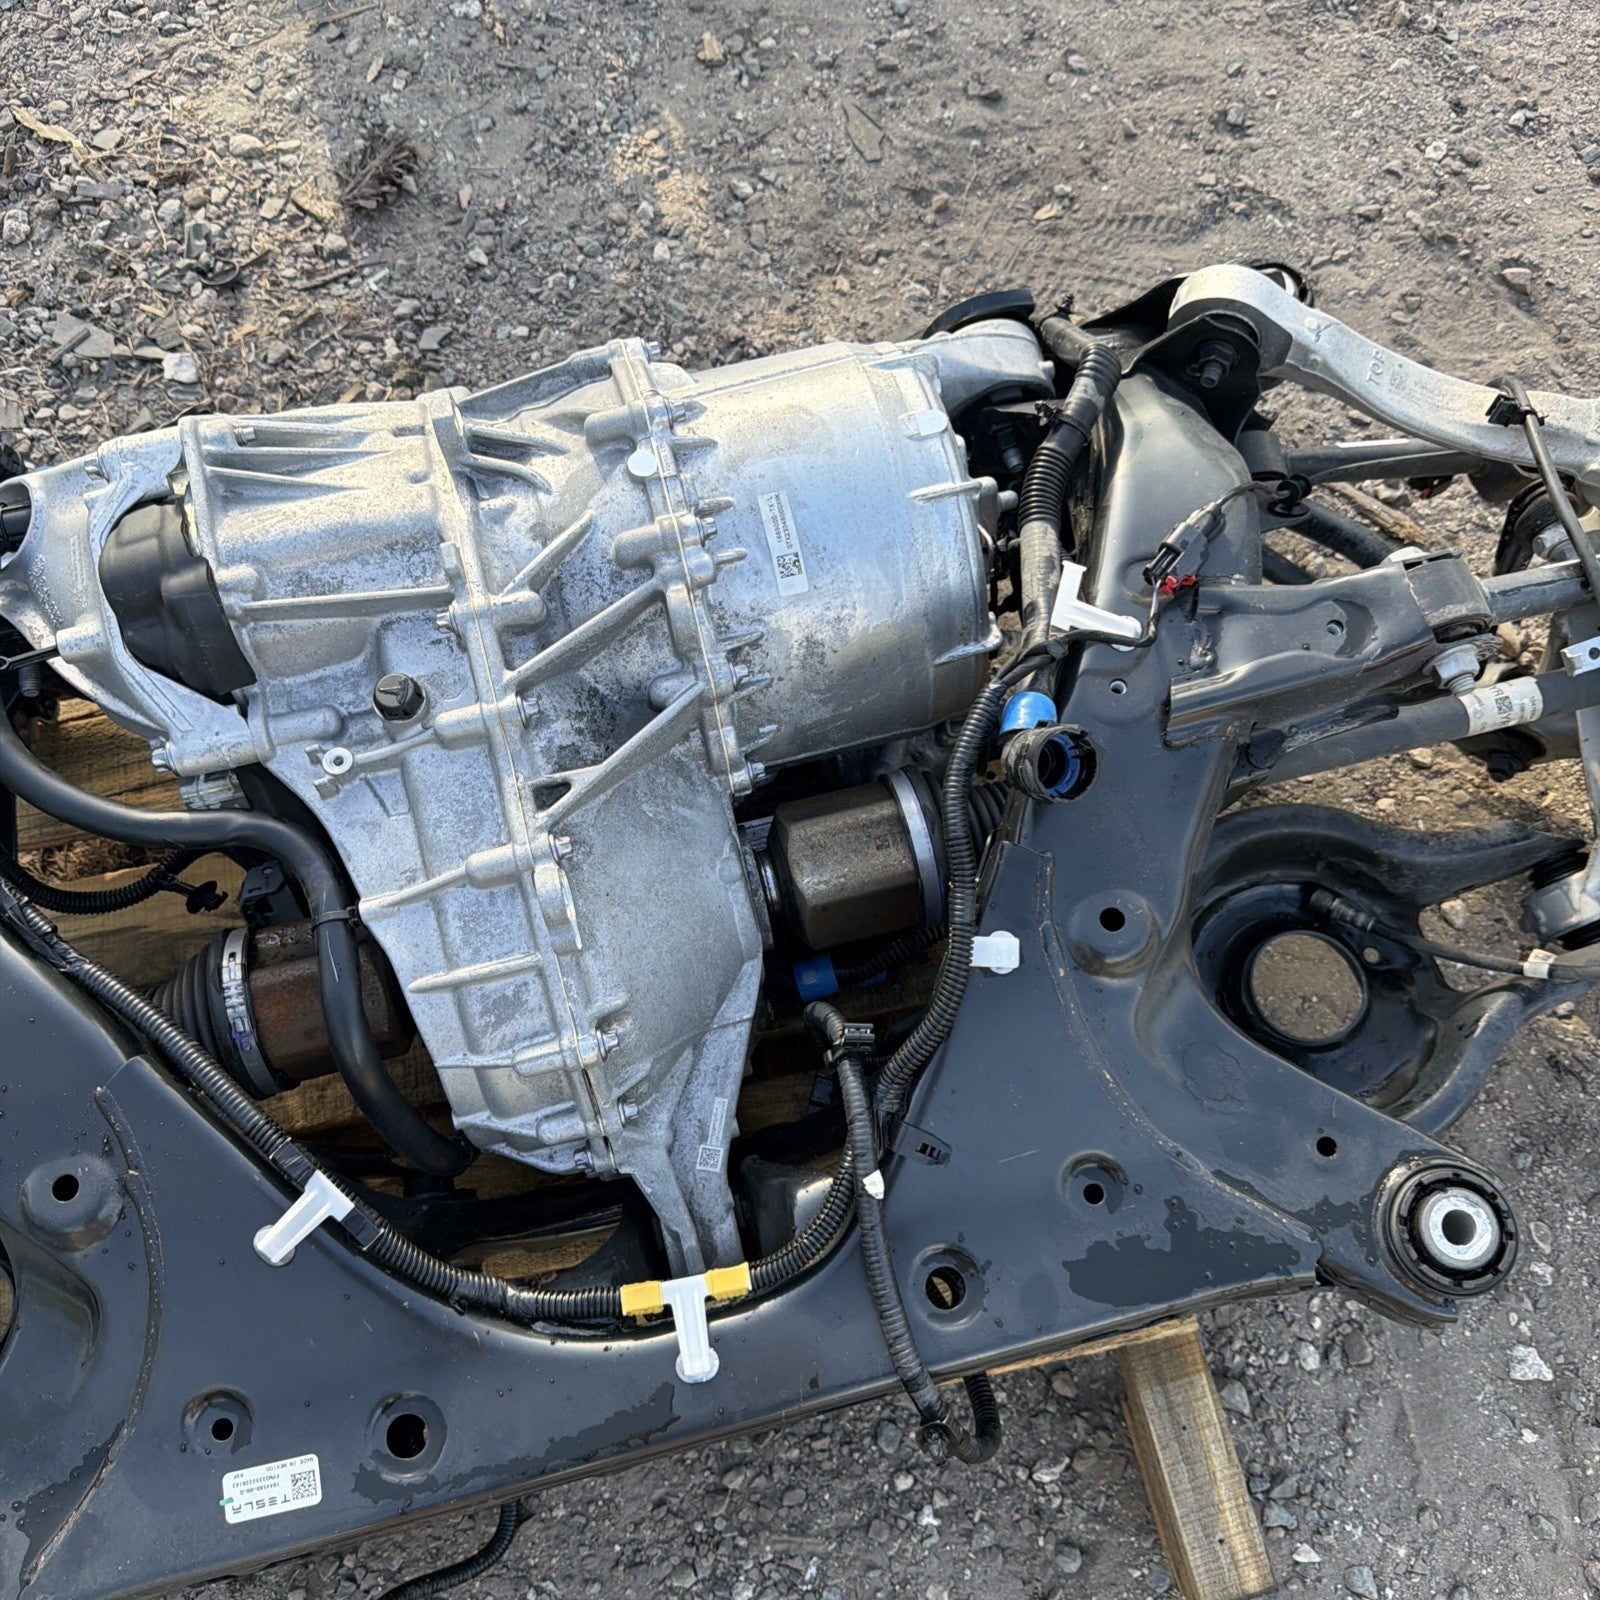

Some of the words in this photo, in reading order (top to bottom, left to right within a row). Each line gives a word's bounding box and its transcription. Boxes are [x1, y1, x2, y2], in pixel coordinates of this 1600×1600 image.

[1365, 349, 1384, 385] TOP
[266, 1463, 287, 1472] MEXICO
[300, 1457, 314, 1465] MADE
[232, 1494, 290, 1514] TESLA
